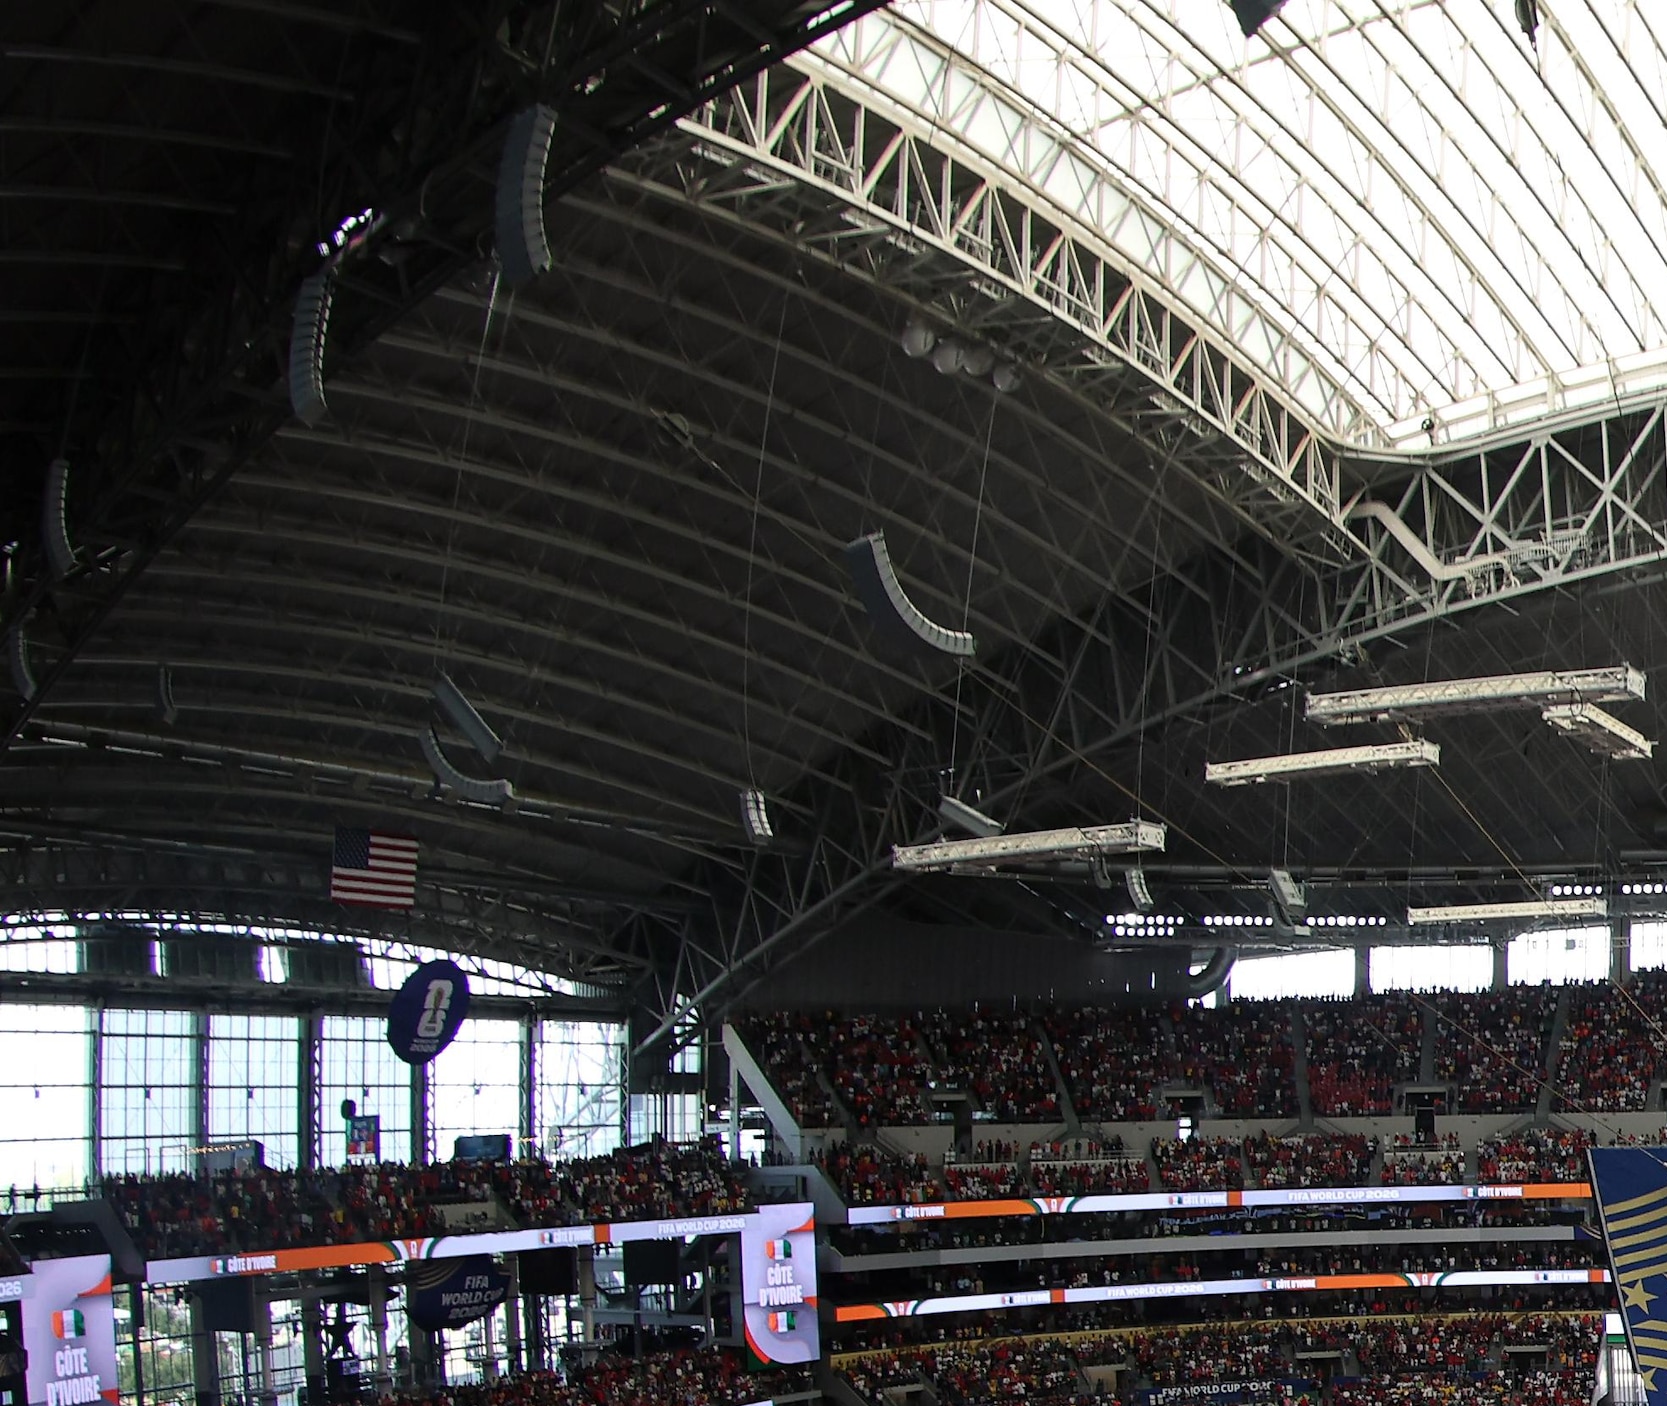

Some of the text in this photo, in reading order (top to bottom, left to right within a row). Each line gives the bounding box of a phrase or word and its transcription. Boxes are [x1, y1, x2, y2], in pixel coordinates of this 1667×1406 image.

[1288, 1189, 1400, 1201] FIFA WORLD CUP 2026
[1478, 1186, 1522, 1197] CÔTE D'IVOIRE
[905, 1205, 945, 1218] CÔTE D'IVOIRE
[658, 1218, 745, 1235] FIFA WORLD CUP 2026
[228, 1255, 277, 1273] CÔTE D'IVOIRE
[767, 1262, 794, 1286] CÔTE
[465, 1275, 489, 1290] FIFA
[1276, 1279, 1316, 1290] CÔTE D'IVOIRE
[759, 1284, 803, 1307] D'IVOIRE
[1108, 1283, 1204, 1298] FIFA WORLD CUP 2026
[441, 1291, 482, 1307] WORLD
[56, 1345, 89, 1377] CÔTE
